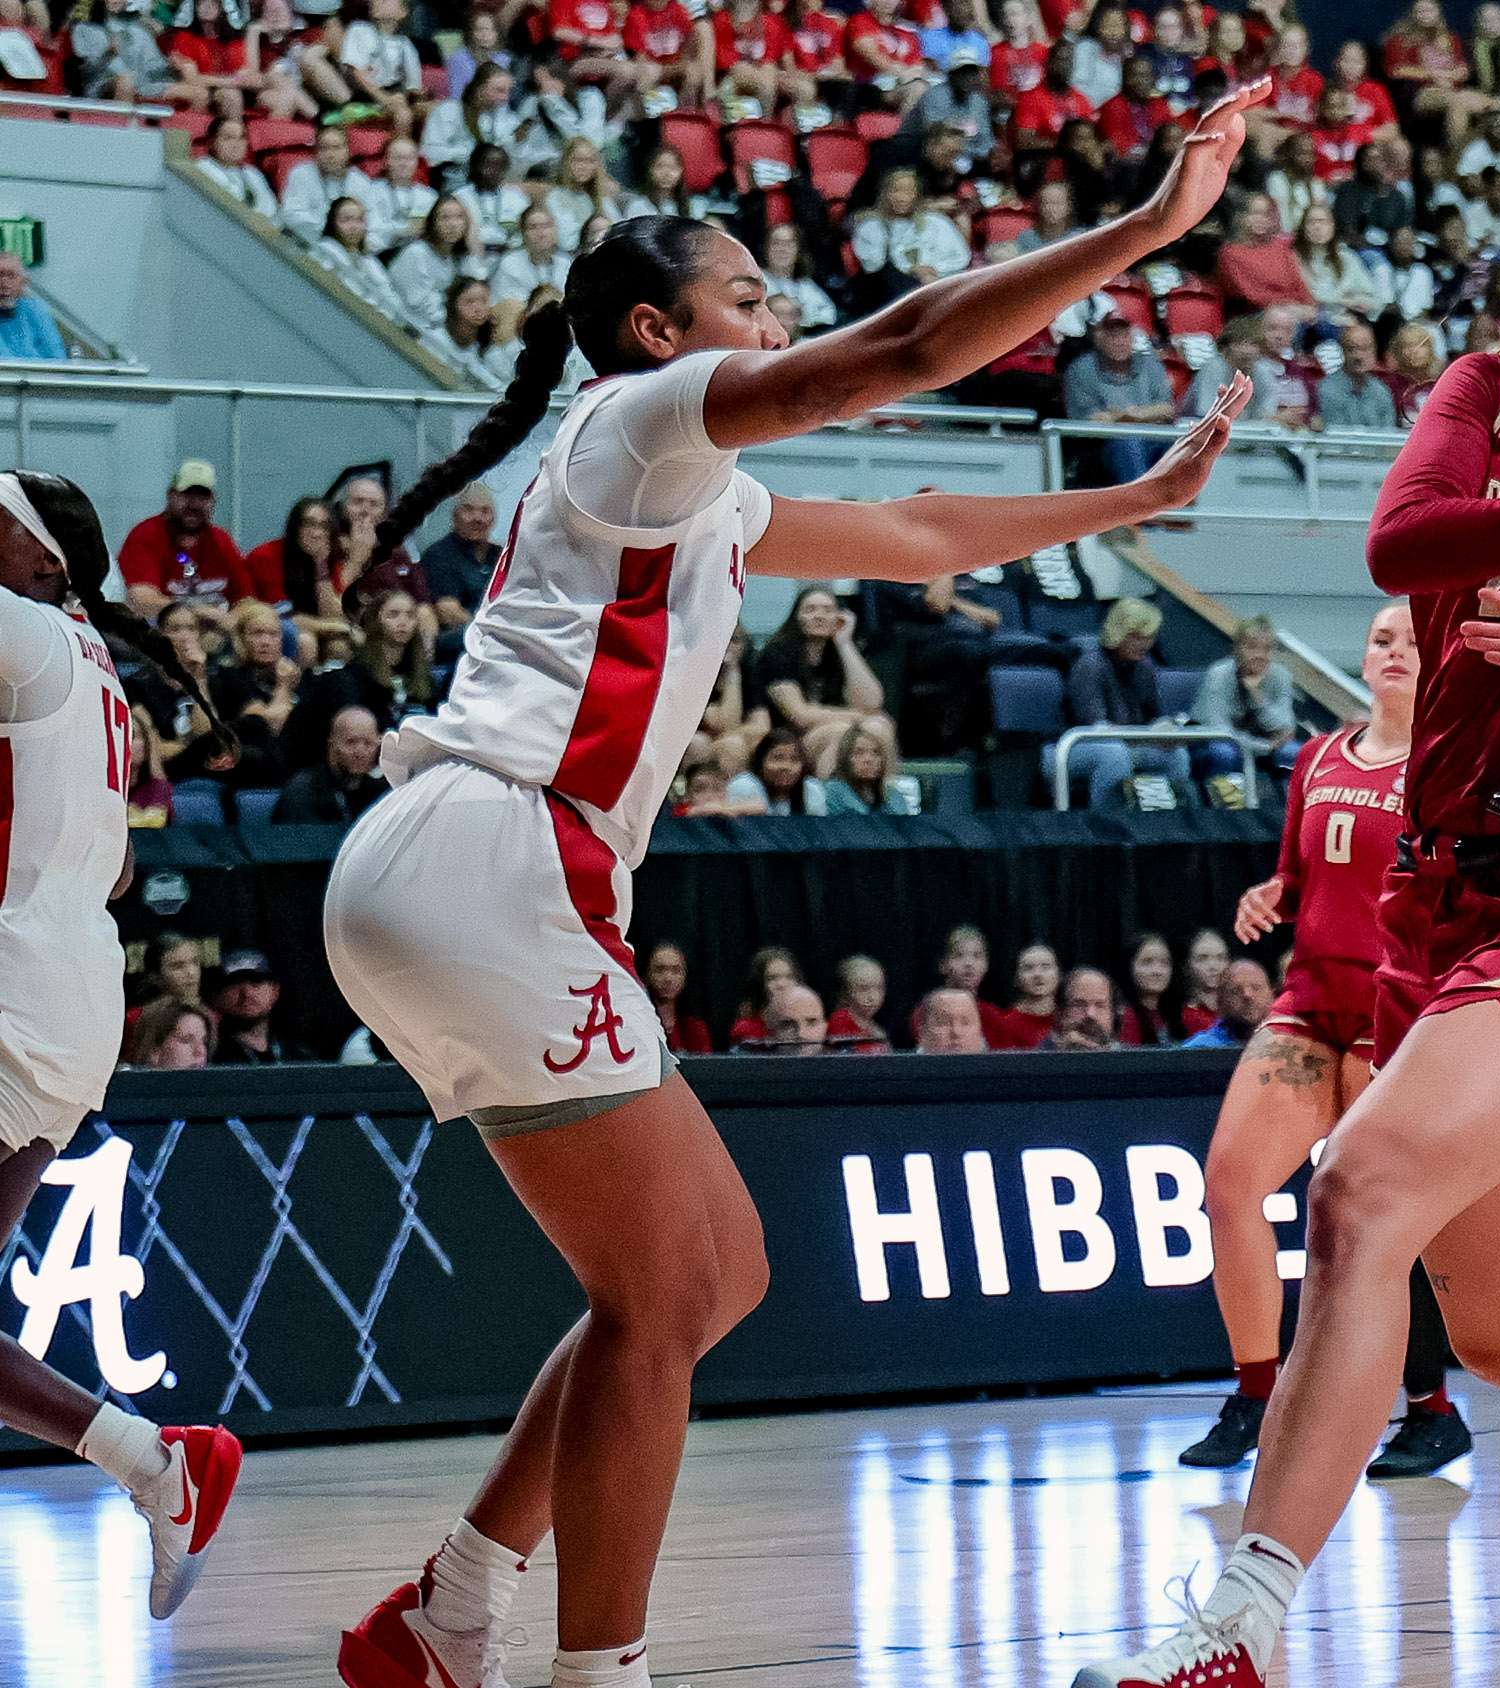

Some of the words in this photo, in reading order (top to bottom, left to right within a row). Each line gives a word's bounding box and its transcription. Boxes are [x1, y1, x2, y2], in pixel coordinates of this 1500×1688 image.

[1325, 811, 1356, 864] 0
[544, 973, 635, 1074] A
[11, 1136, 167, 1394] A
